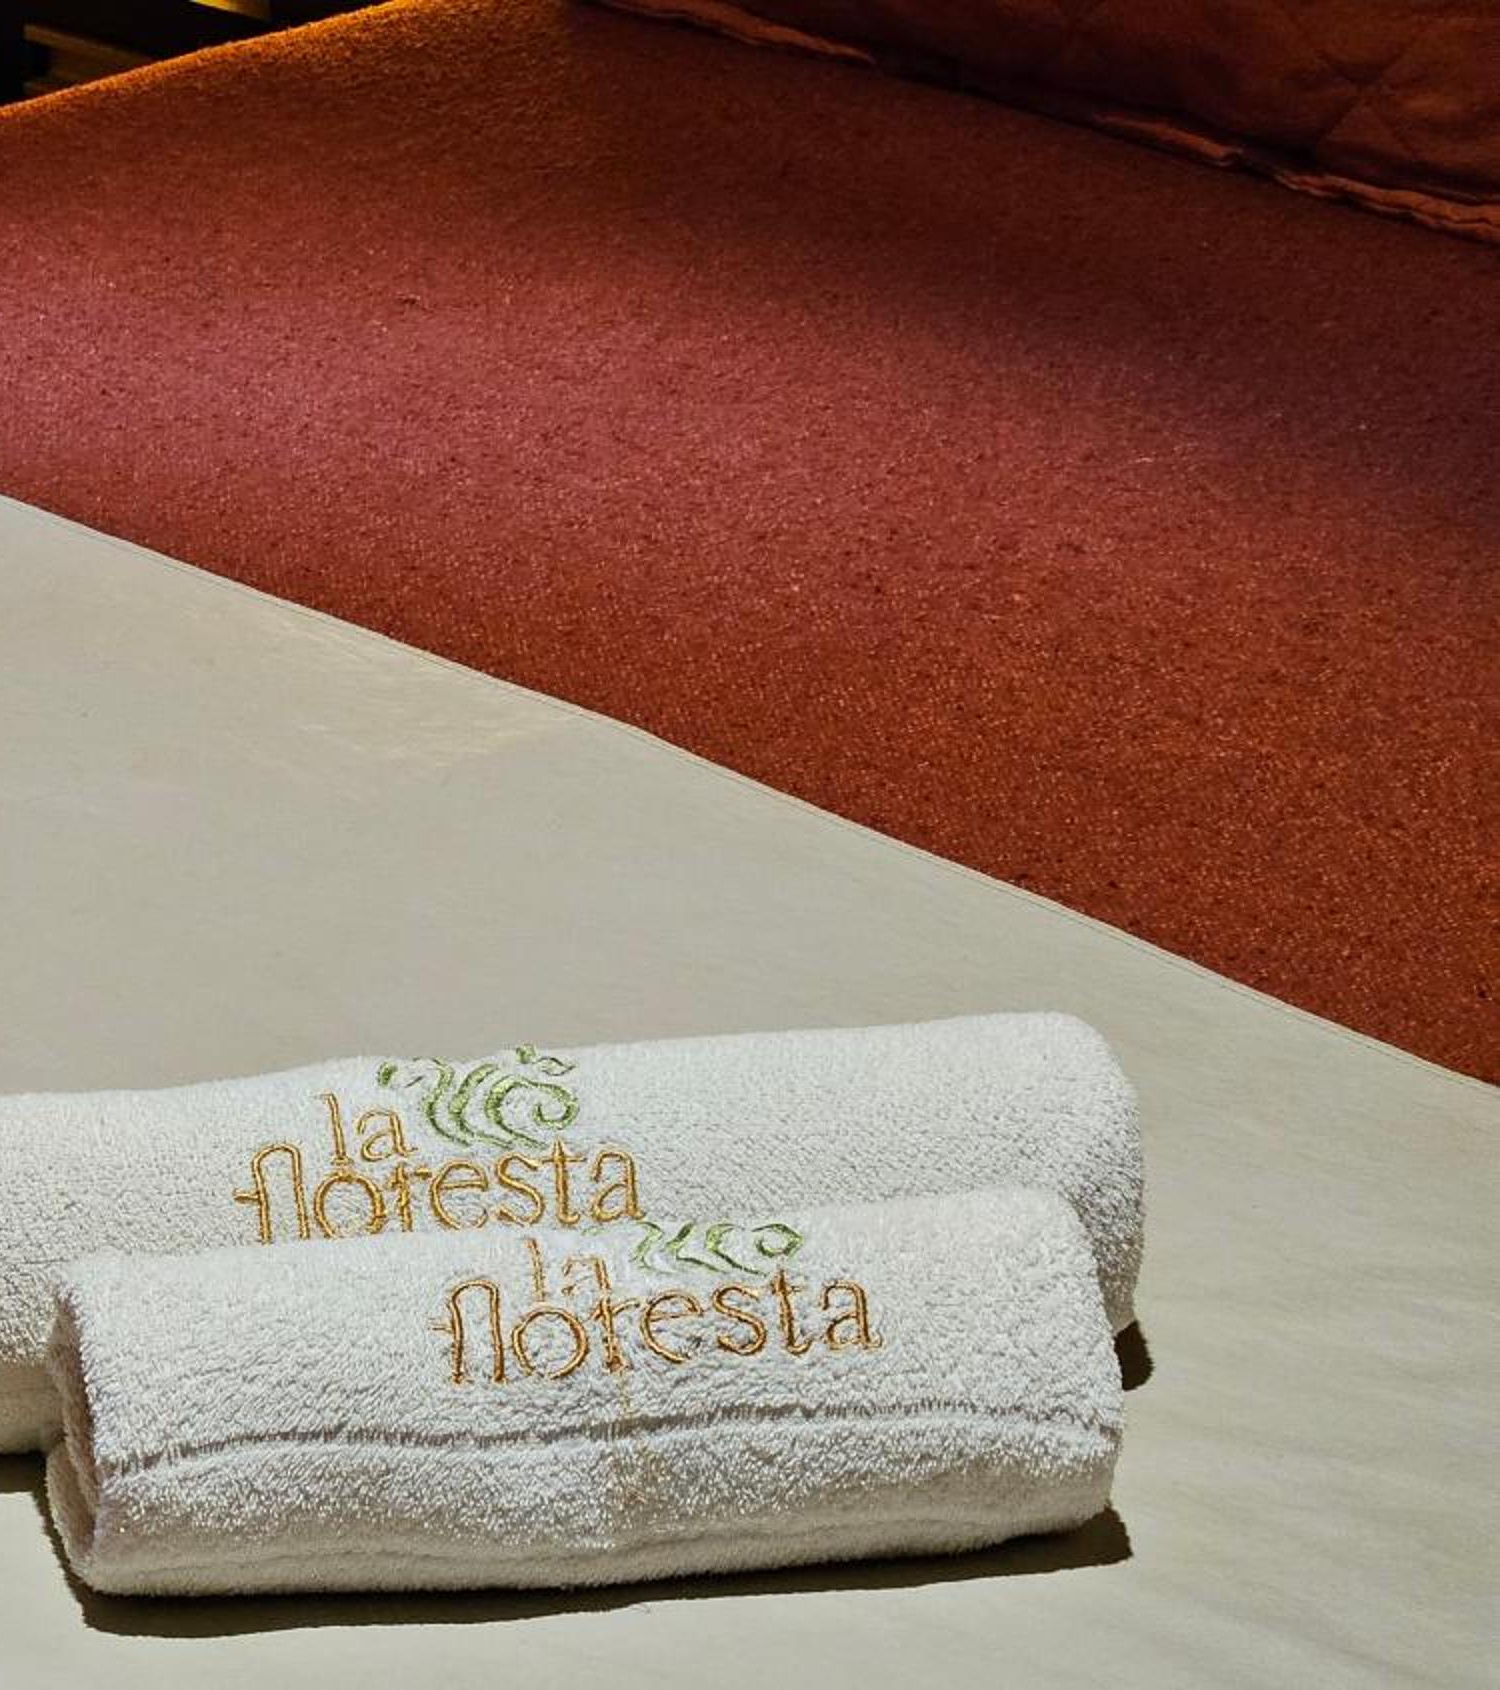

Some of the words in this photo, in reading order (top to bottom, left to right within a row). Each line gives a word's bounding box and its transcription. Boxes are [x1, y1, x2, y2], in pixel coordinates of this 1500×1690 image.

[320, 1093, 418, 1166] la
[233, 1141, 646, 1244] floresta
[524, 1238, 613, 1302] la
[428, 1268, 884, 1384] floresta
